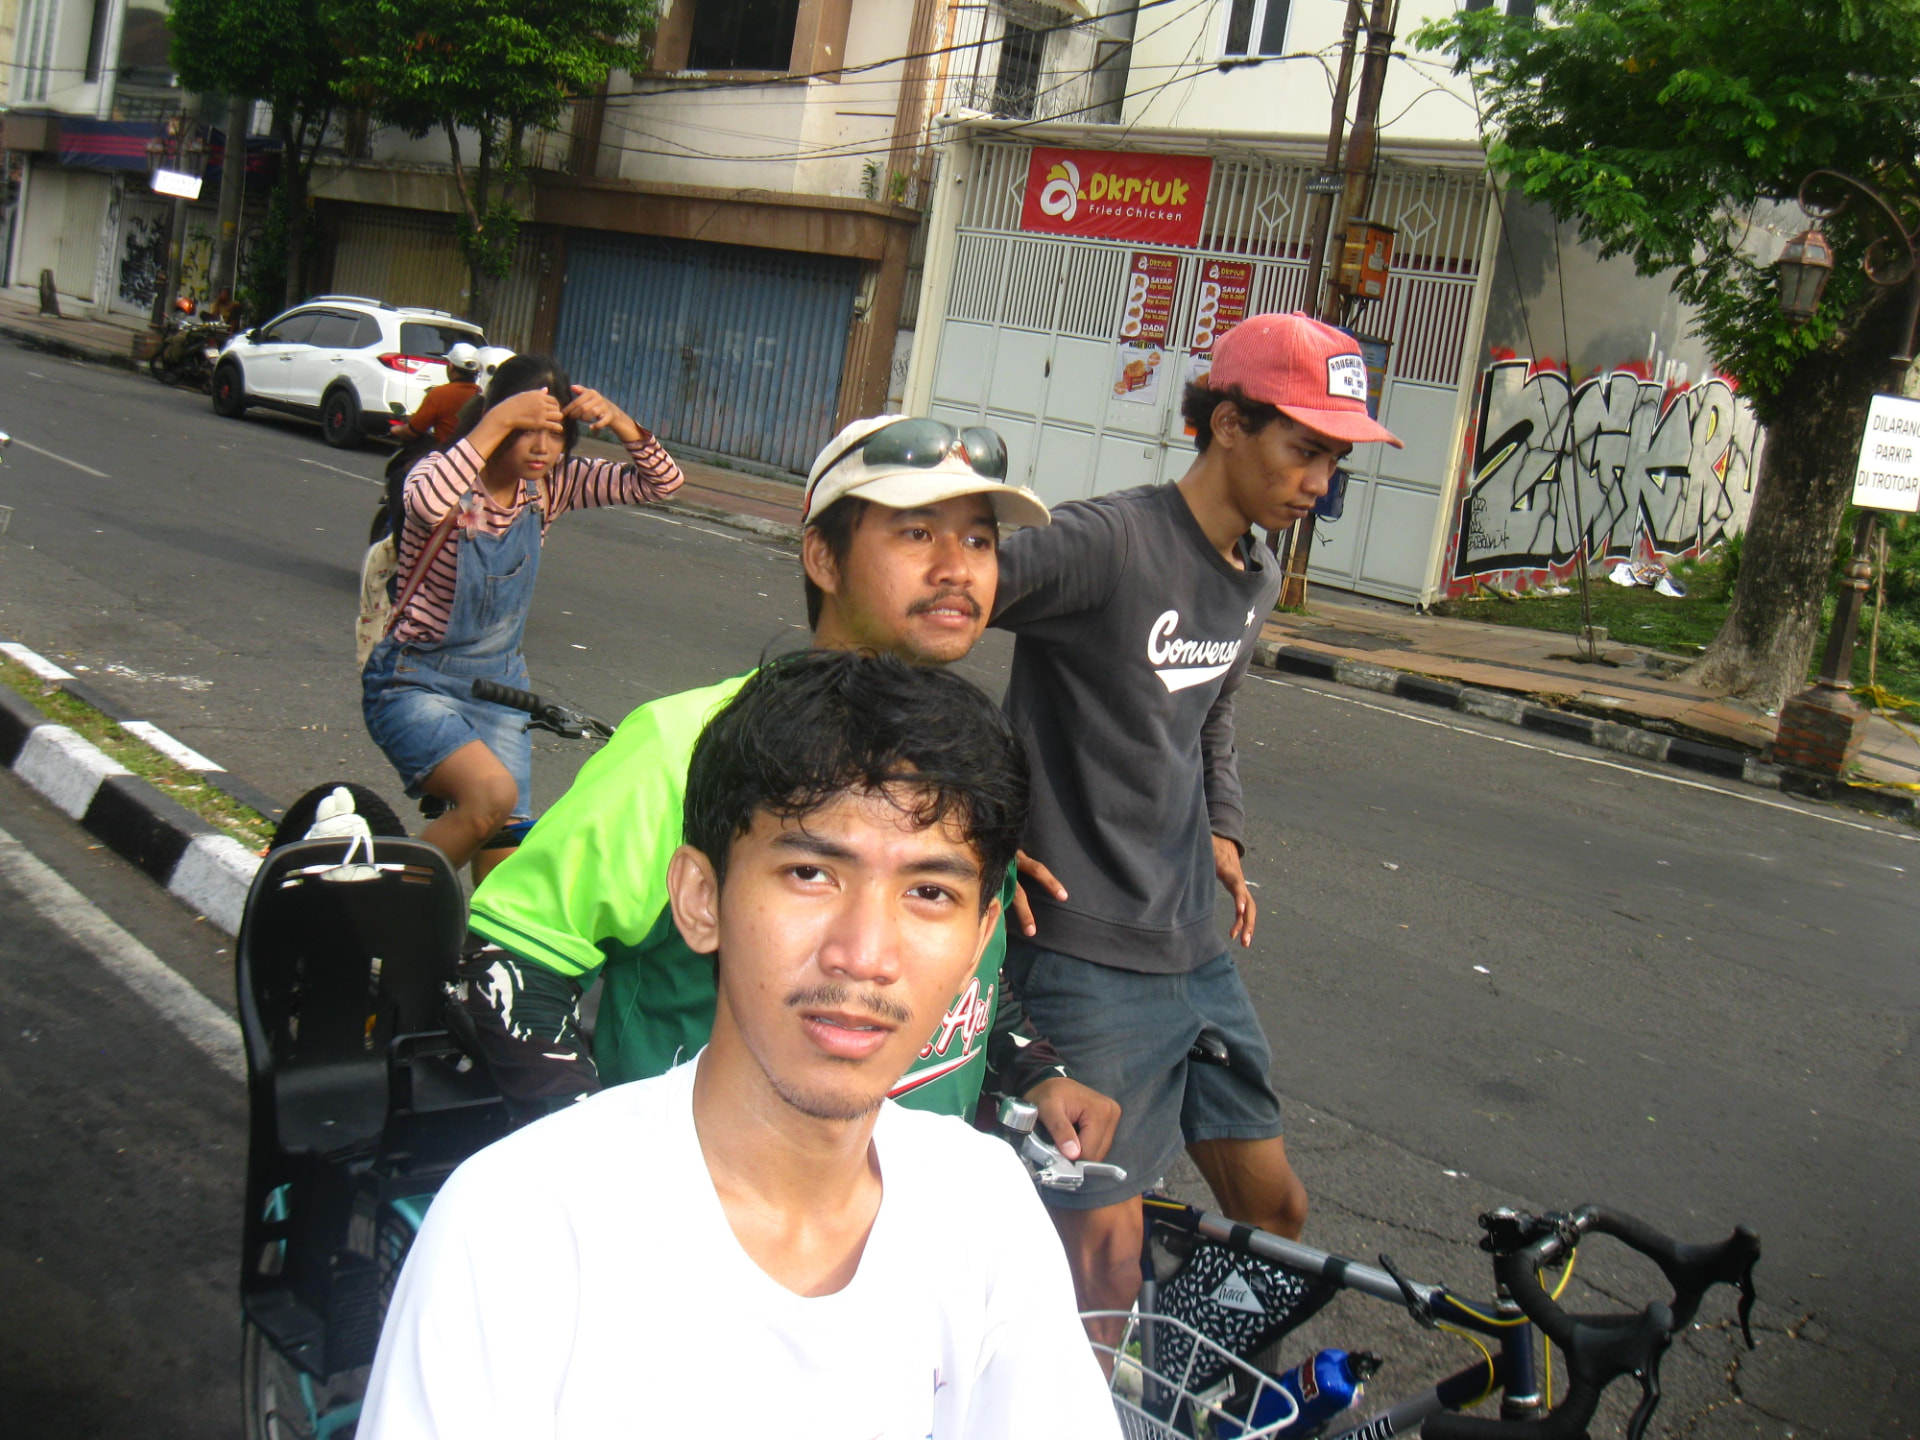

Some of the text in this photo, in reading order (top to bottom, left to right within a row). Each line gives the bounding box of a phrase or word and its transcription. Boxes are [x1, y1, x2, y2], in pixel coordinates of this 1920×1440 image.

[1088, 203, 1182, 222] Fried Chicken
[1222, 286, 1246, 294] SAYAP
[1142, 323, 1165, 332] DADA
[1874, 444, 1912, 464] PARKIR
[1857, 470, 1919, 493] DI TROTOAR
